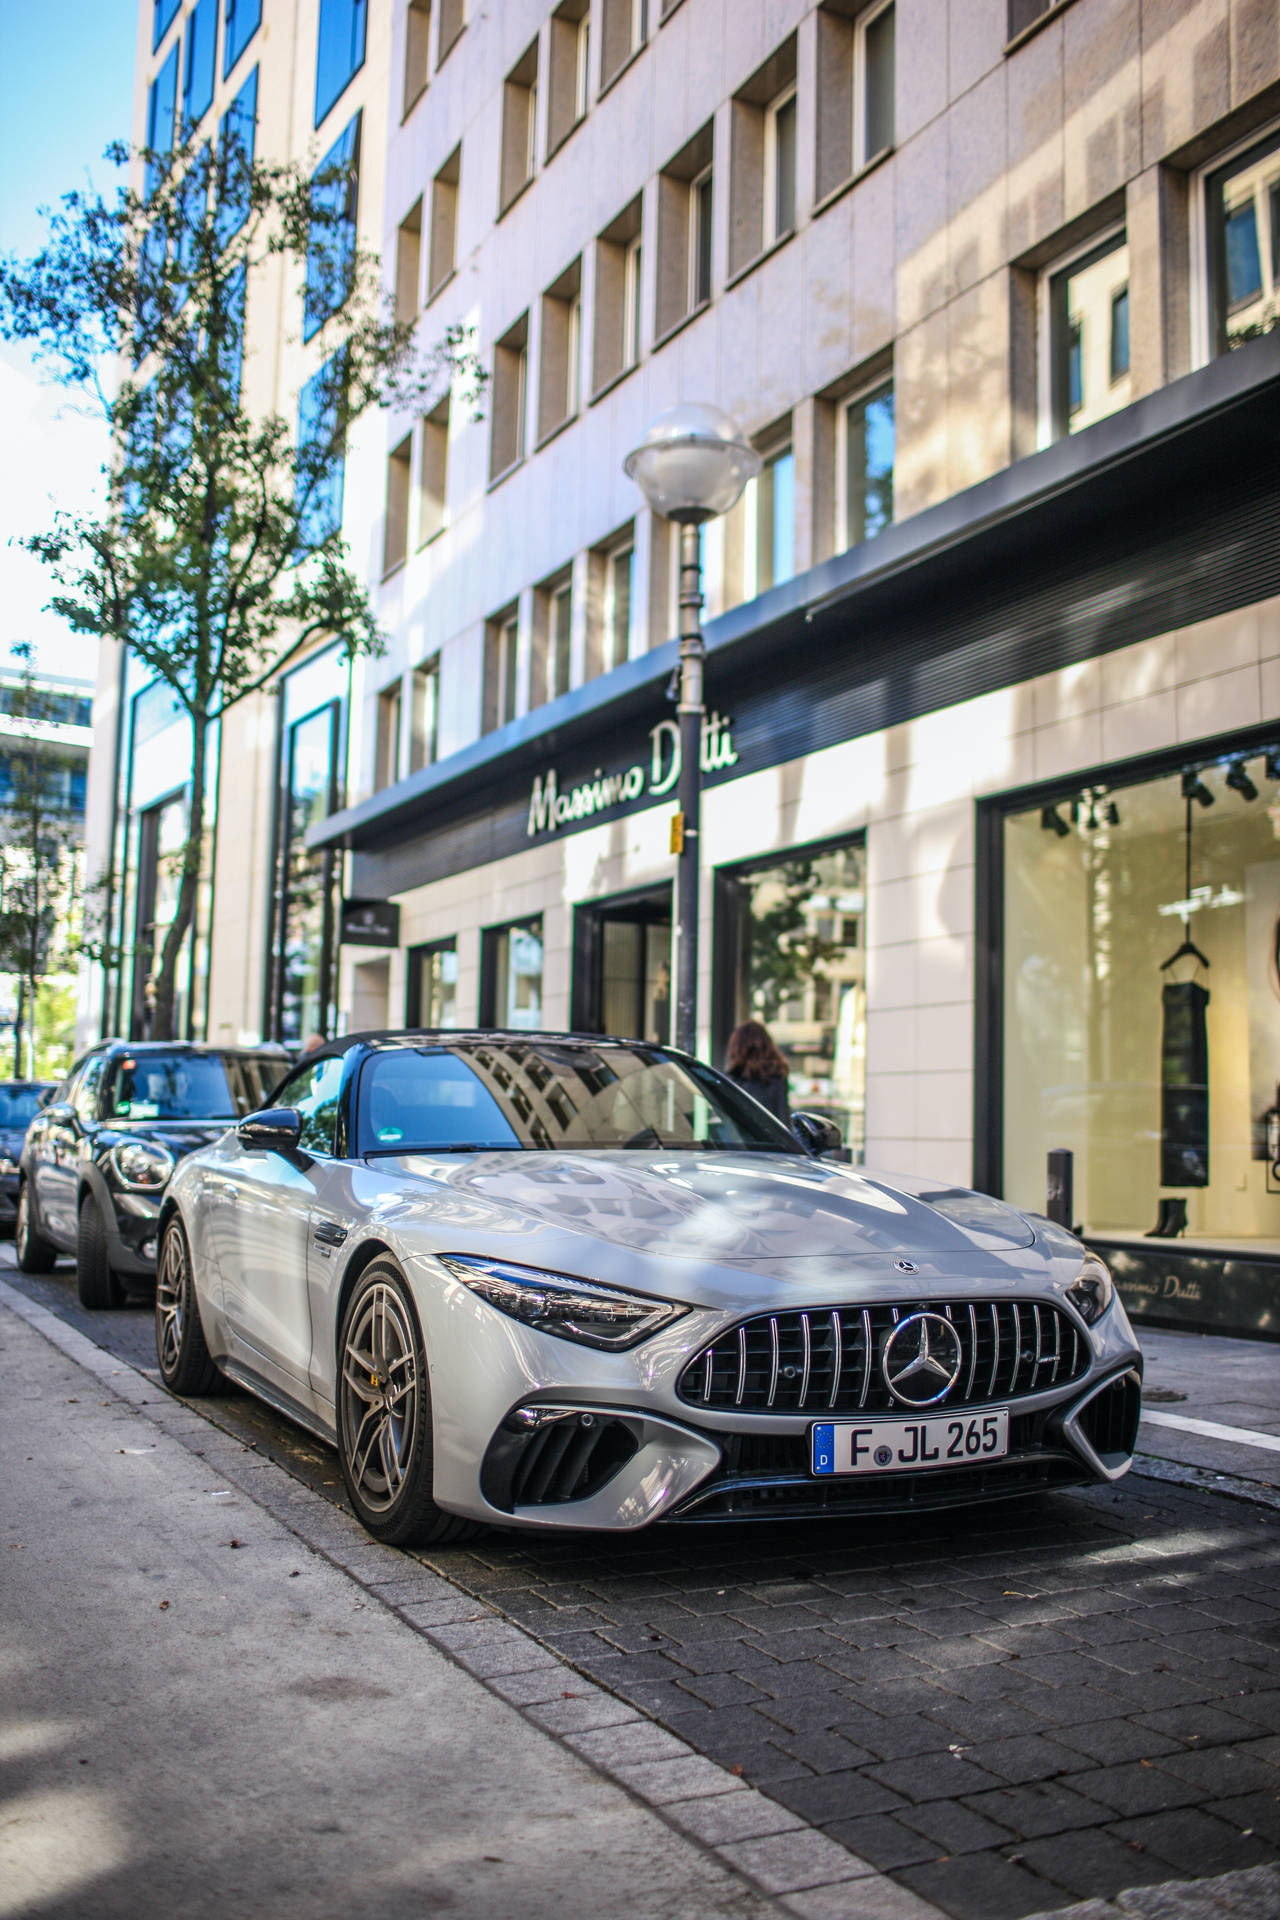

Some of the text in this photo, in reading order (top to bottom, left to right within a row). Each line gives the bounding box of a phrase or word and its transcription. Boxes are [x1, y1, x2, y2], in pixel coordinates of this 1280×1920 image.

[527, 711, 738, 836] Massimo Dtti
[820, 1454, 828, 1466] D
[851, 1417, 998, 1466] F JL 265
